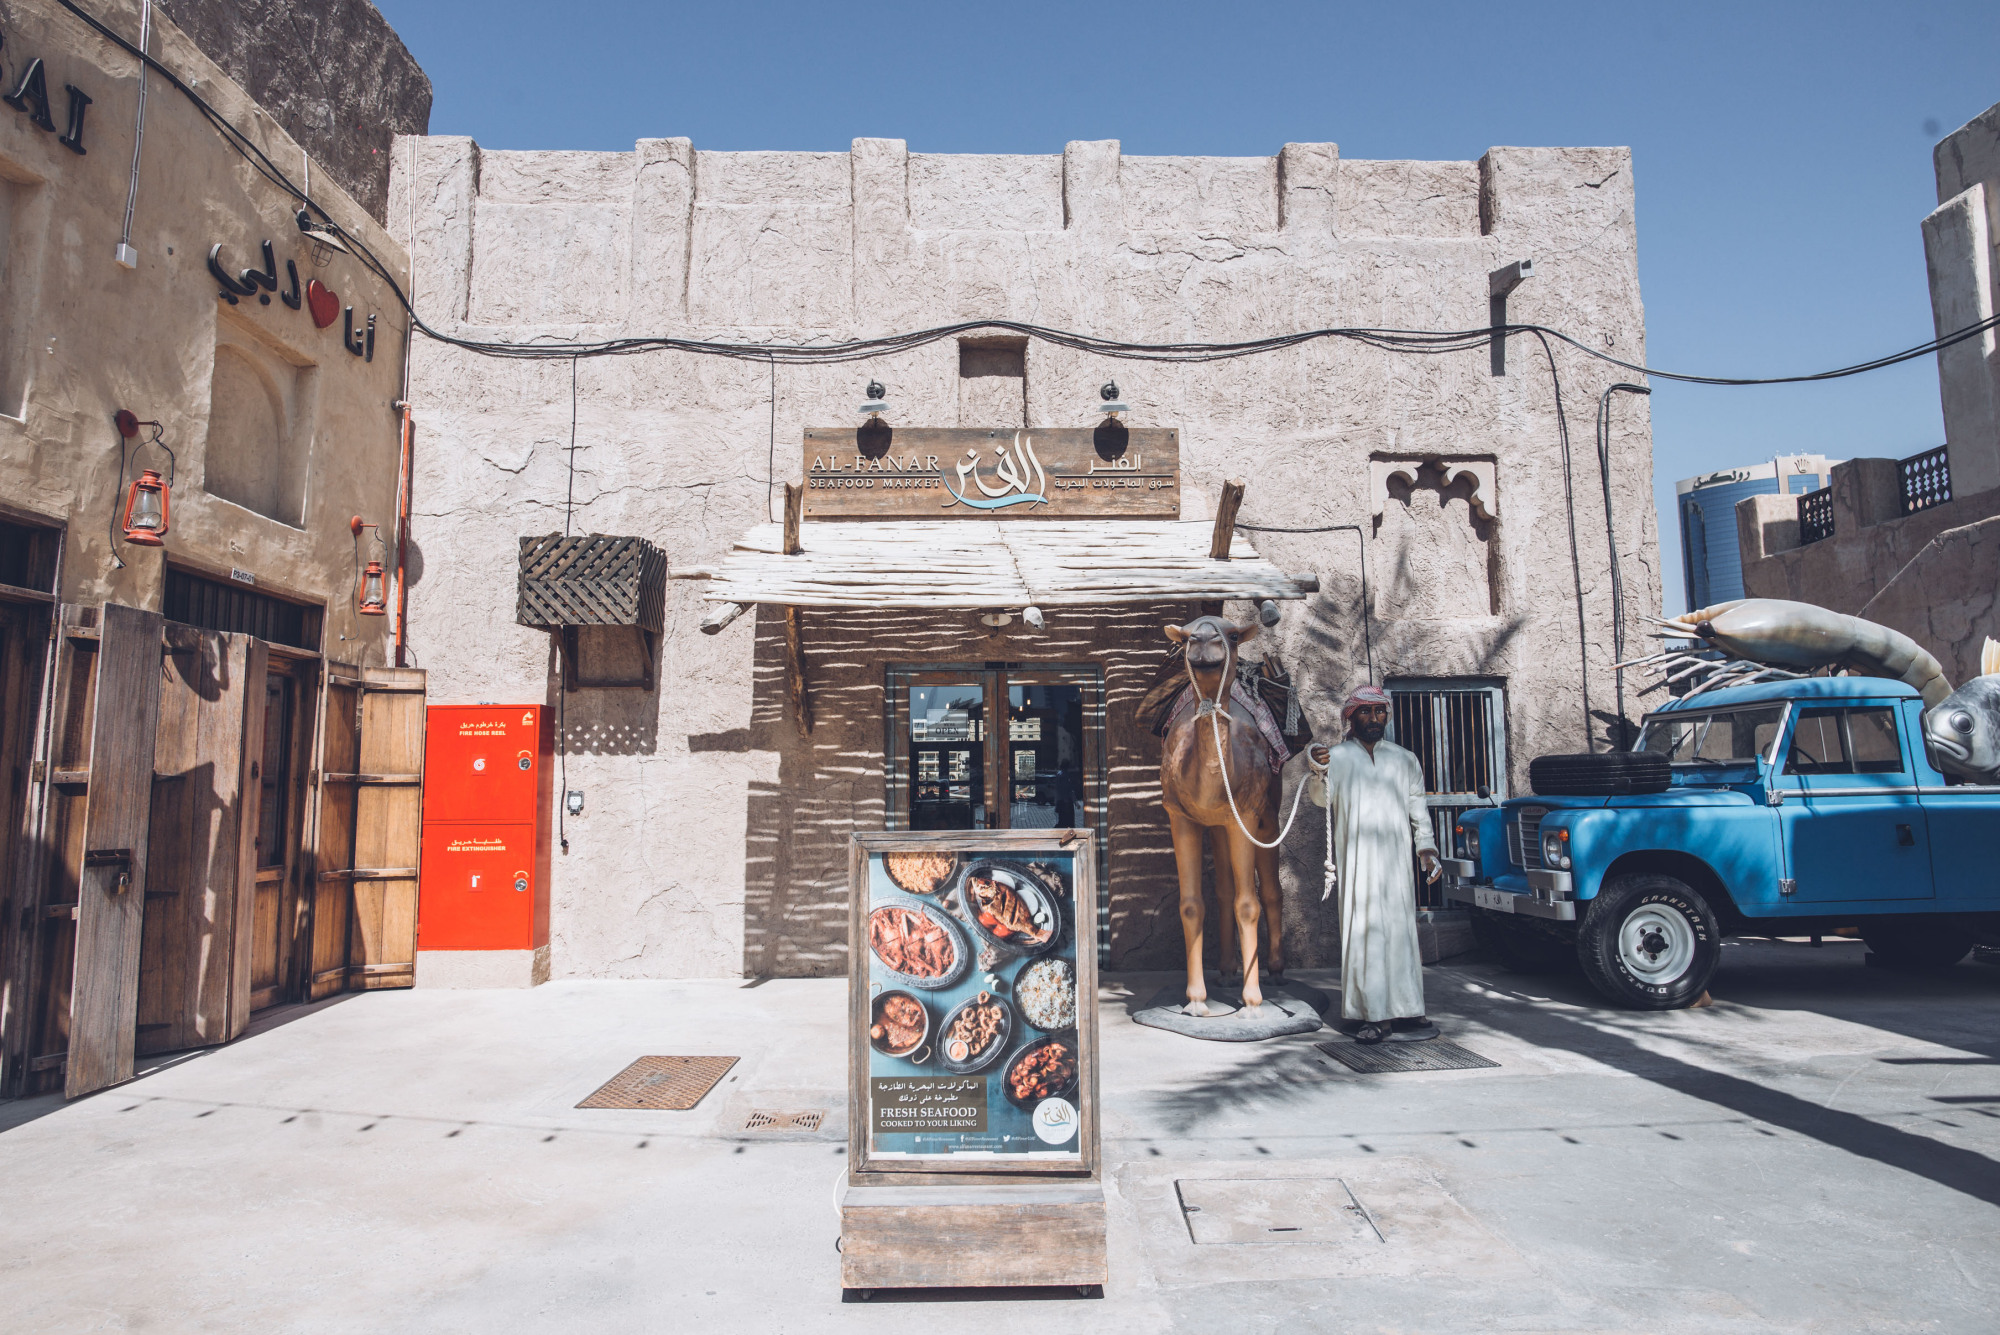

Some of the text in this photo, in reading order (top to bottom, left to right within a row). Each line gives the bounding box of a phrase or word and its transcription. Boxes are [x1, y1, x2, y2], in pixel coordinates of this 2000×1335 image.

[0, 30, 93, 155] AI
[207, 239, 302, 311] دبي
[810, 455, 941, 473] AL-FANAR
[1087, 453, 1142, 476] الفنر
[810, 478, 941, 489] SEAFOOD MARKET
[1054, 478, 1089, 490] البحرية
[1148, 479, 1175, 490] سوق
[935, 727, 959, 735] OPEN
[1641, 895, 1708, 942] GRANDTREK
[1614, 953, 1668, 995] DUNLOP
[878, 1080, 979, 1093] المأكولات البحرية الطازجة
[898, 1093, 959, 1105] مطبوخة على ذوقك
[880, 1107, 977, 1118] FRESH SEAFOOD
